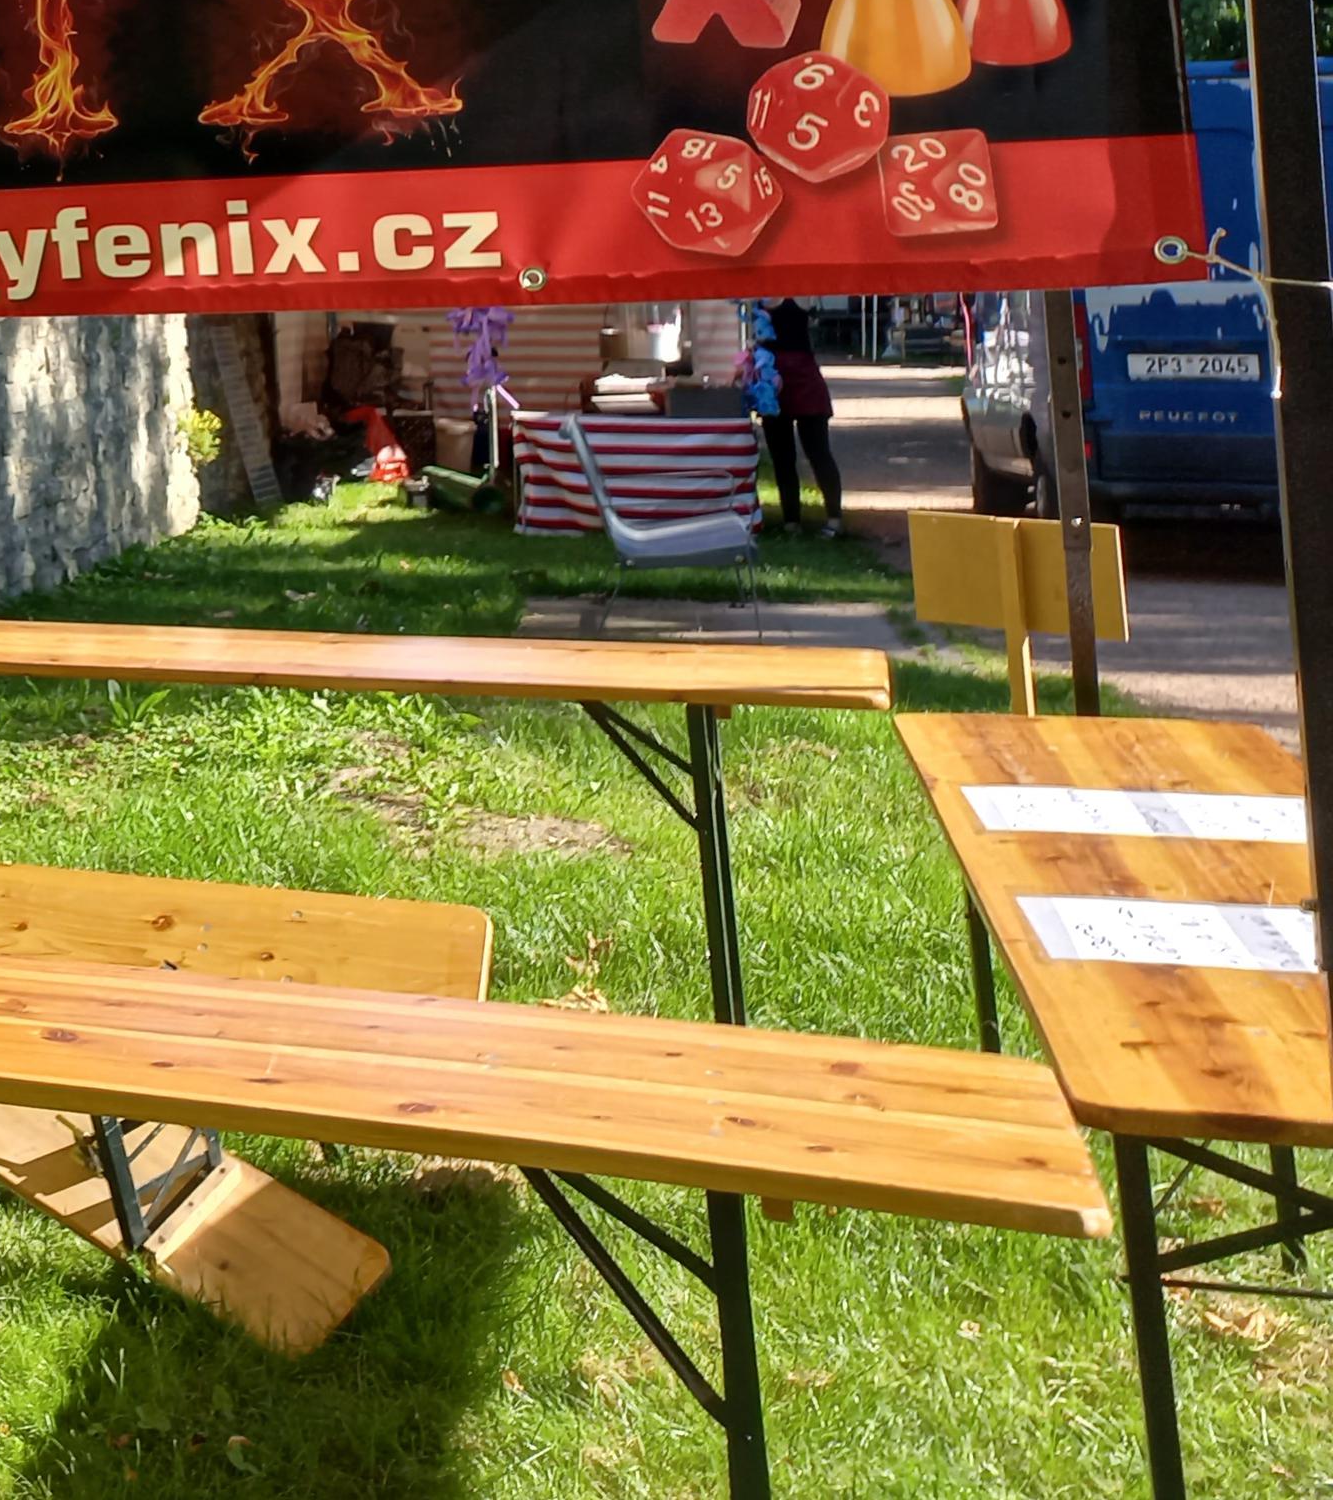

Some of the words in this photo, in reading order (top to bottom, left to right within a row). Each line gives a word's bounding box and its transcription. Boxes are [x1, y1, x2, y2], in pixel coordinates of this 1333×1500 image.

[787, 112, 829, 151] 5
[891, 137, 947, 173] 20
[716, 163, 743, 191] 5
[685, 201, 724, 233] 13
